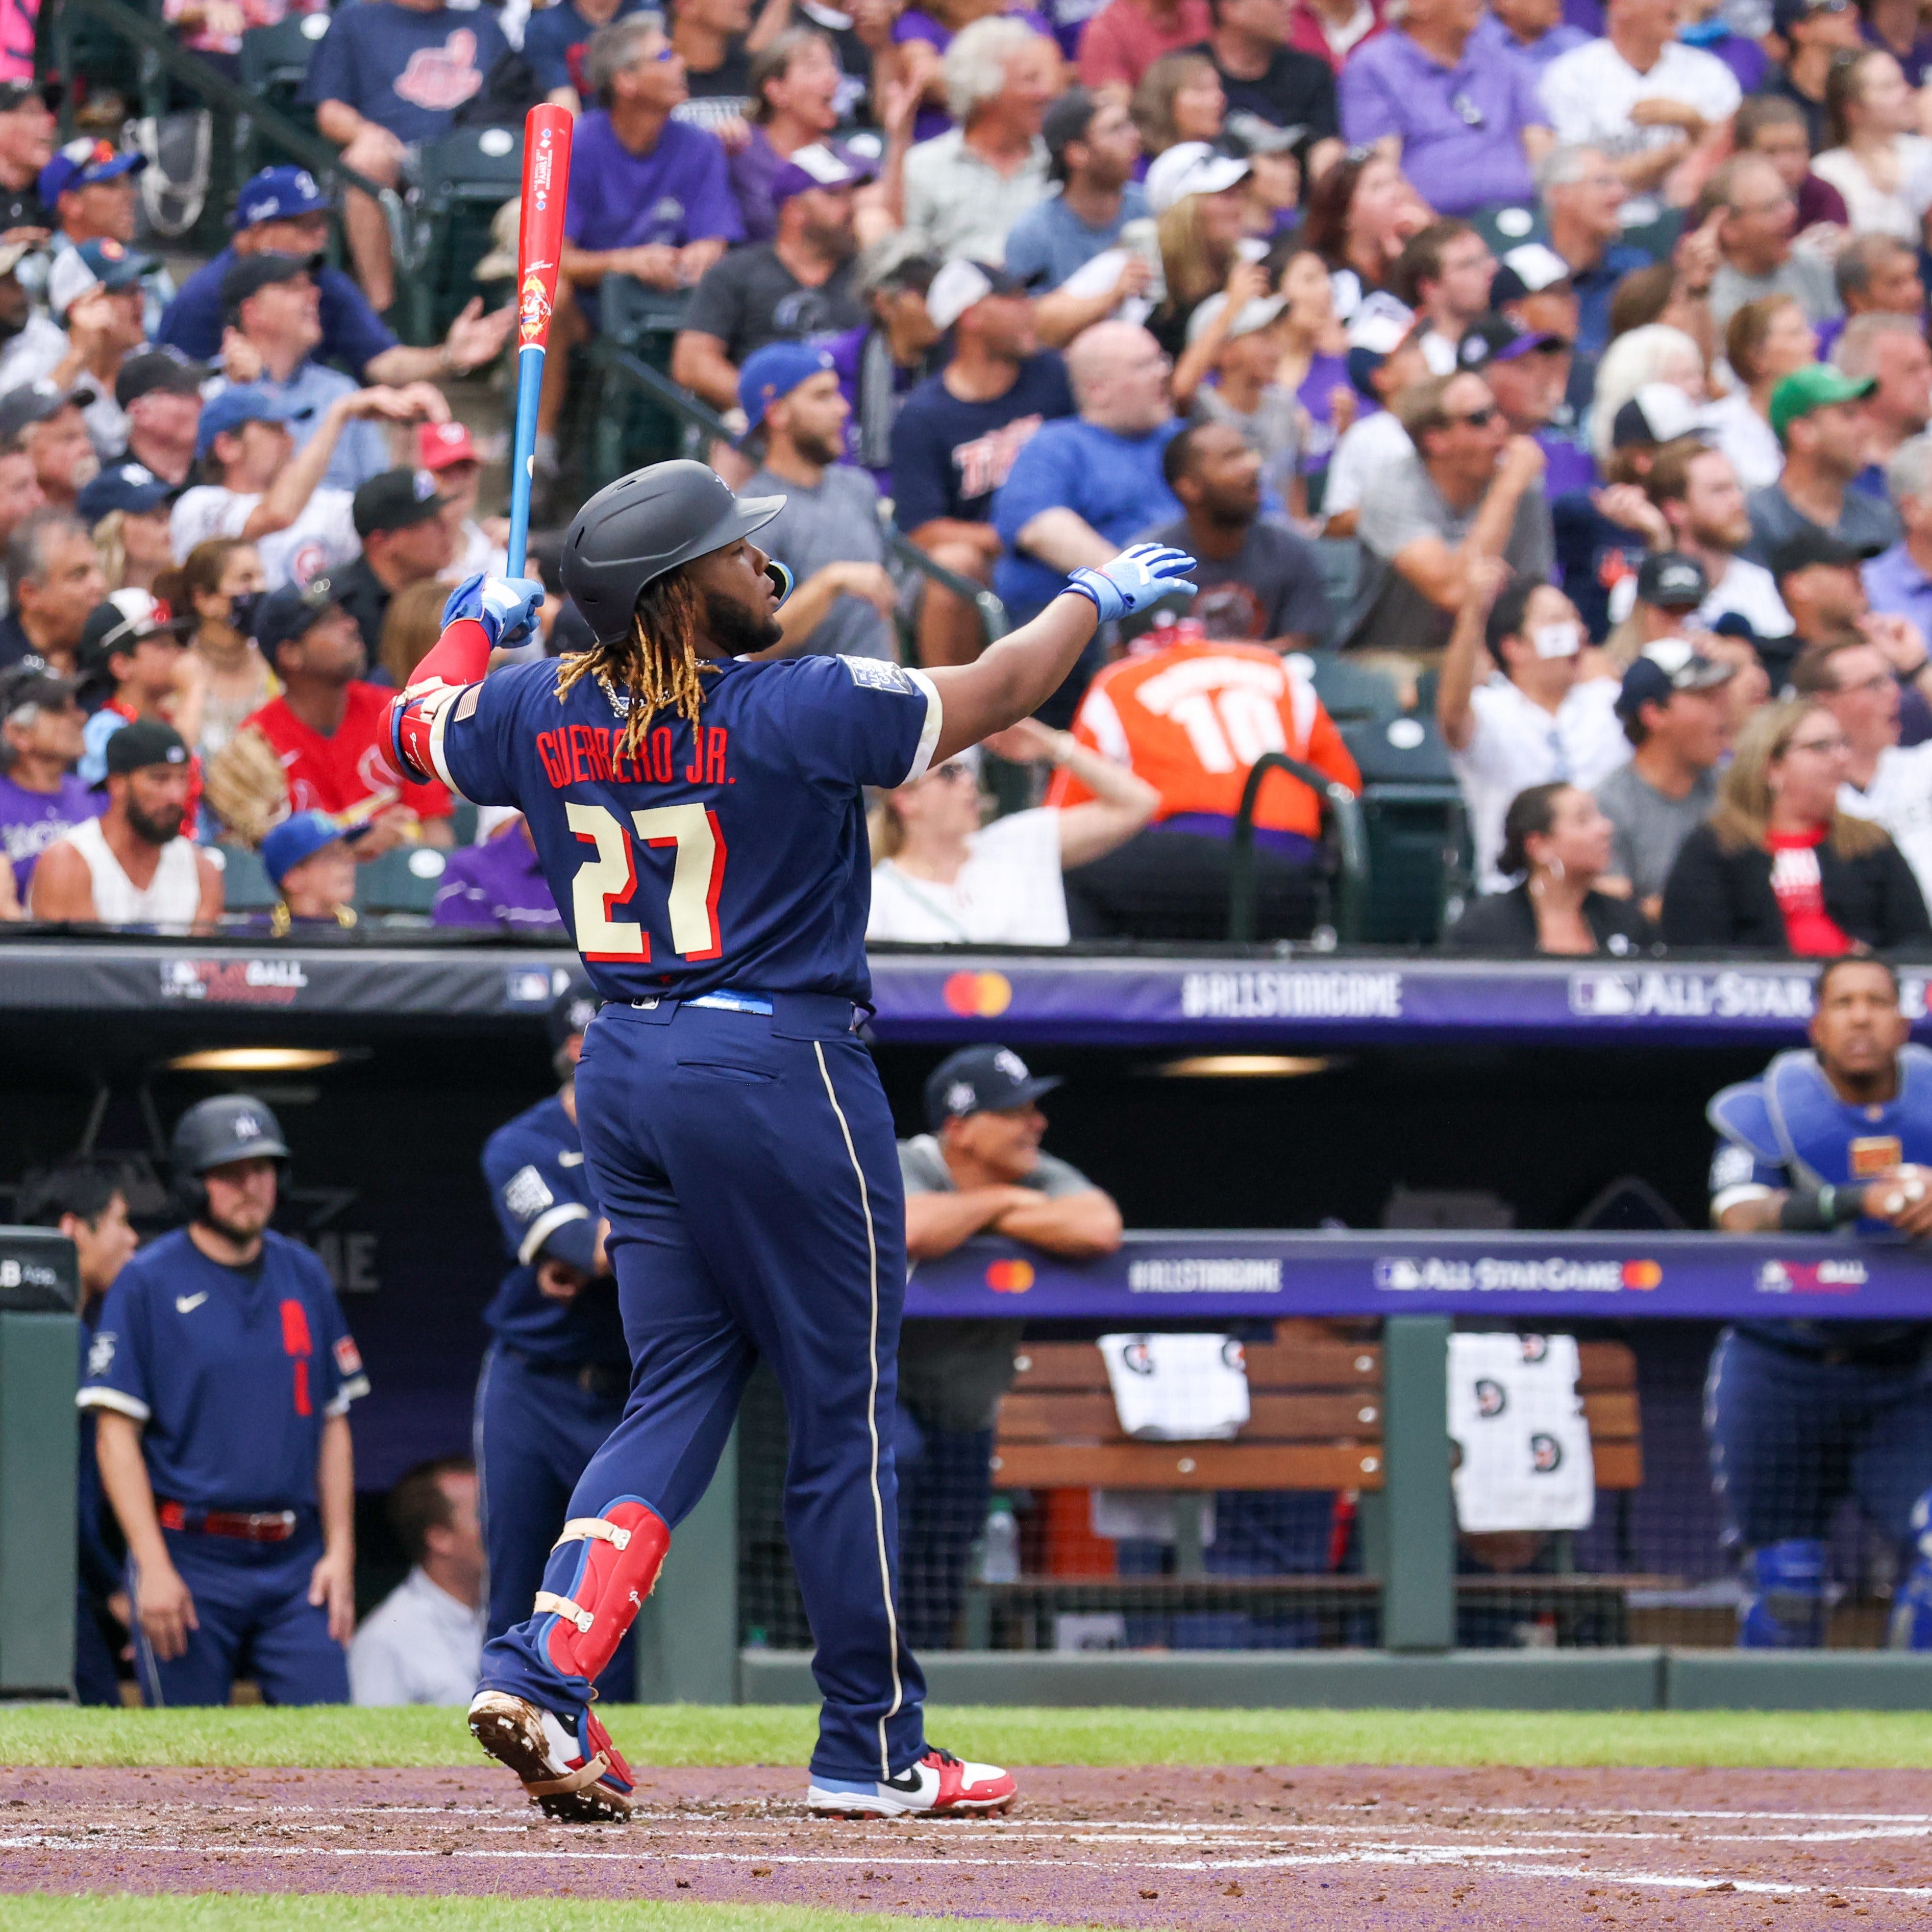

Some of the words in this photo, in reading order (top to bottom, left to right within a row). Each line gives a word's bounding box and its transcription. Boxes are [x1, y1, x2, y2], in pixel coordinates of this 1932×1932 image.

[537, 155, 548, 184] FAMILY
[1168, 688, 1287, 774] 10
[536, 724, 673, 788] GUERRERO
[686, 726, 736, 784] JR.
[565, 801, 728, 963] 27
[245, 959, 309, 987] BALL
[1182, 973, 1403, 1018] #ALLSTARGAME
[1128, 1258, 1283, 1293] #ALLSTARGAME
